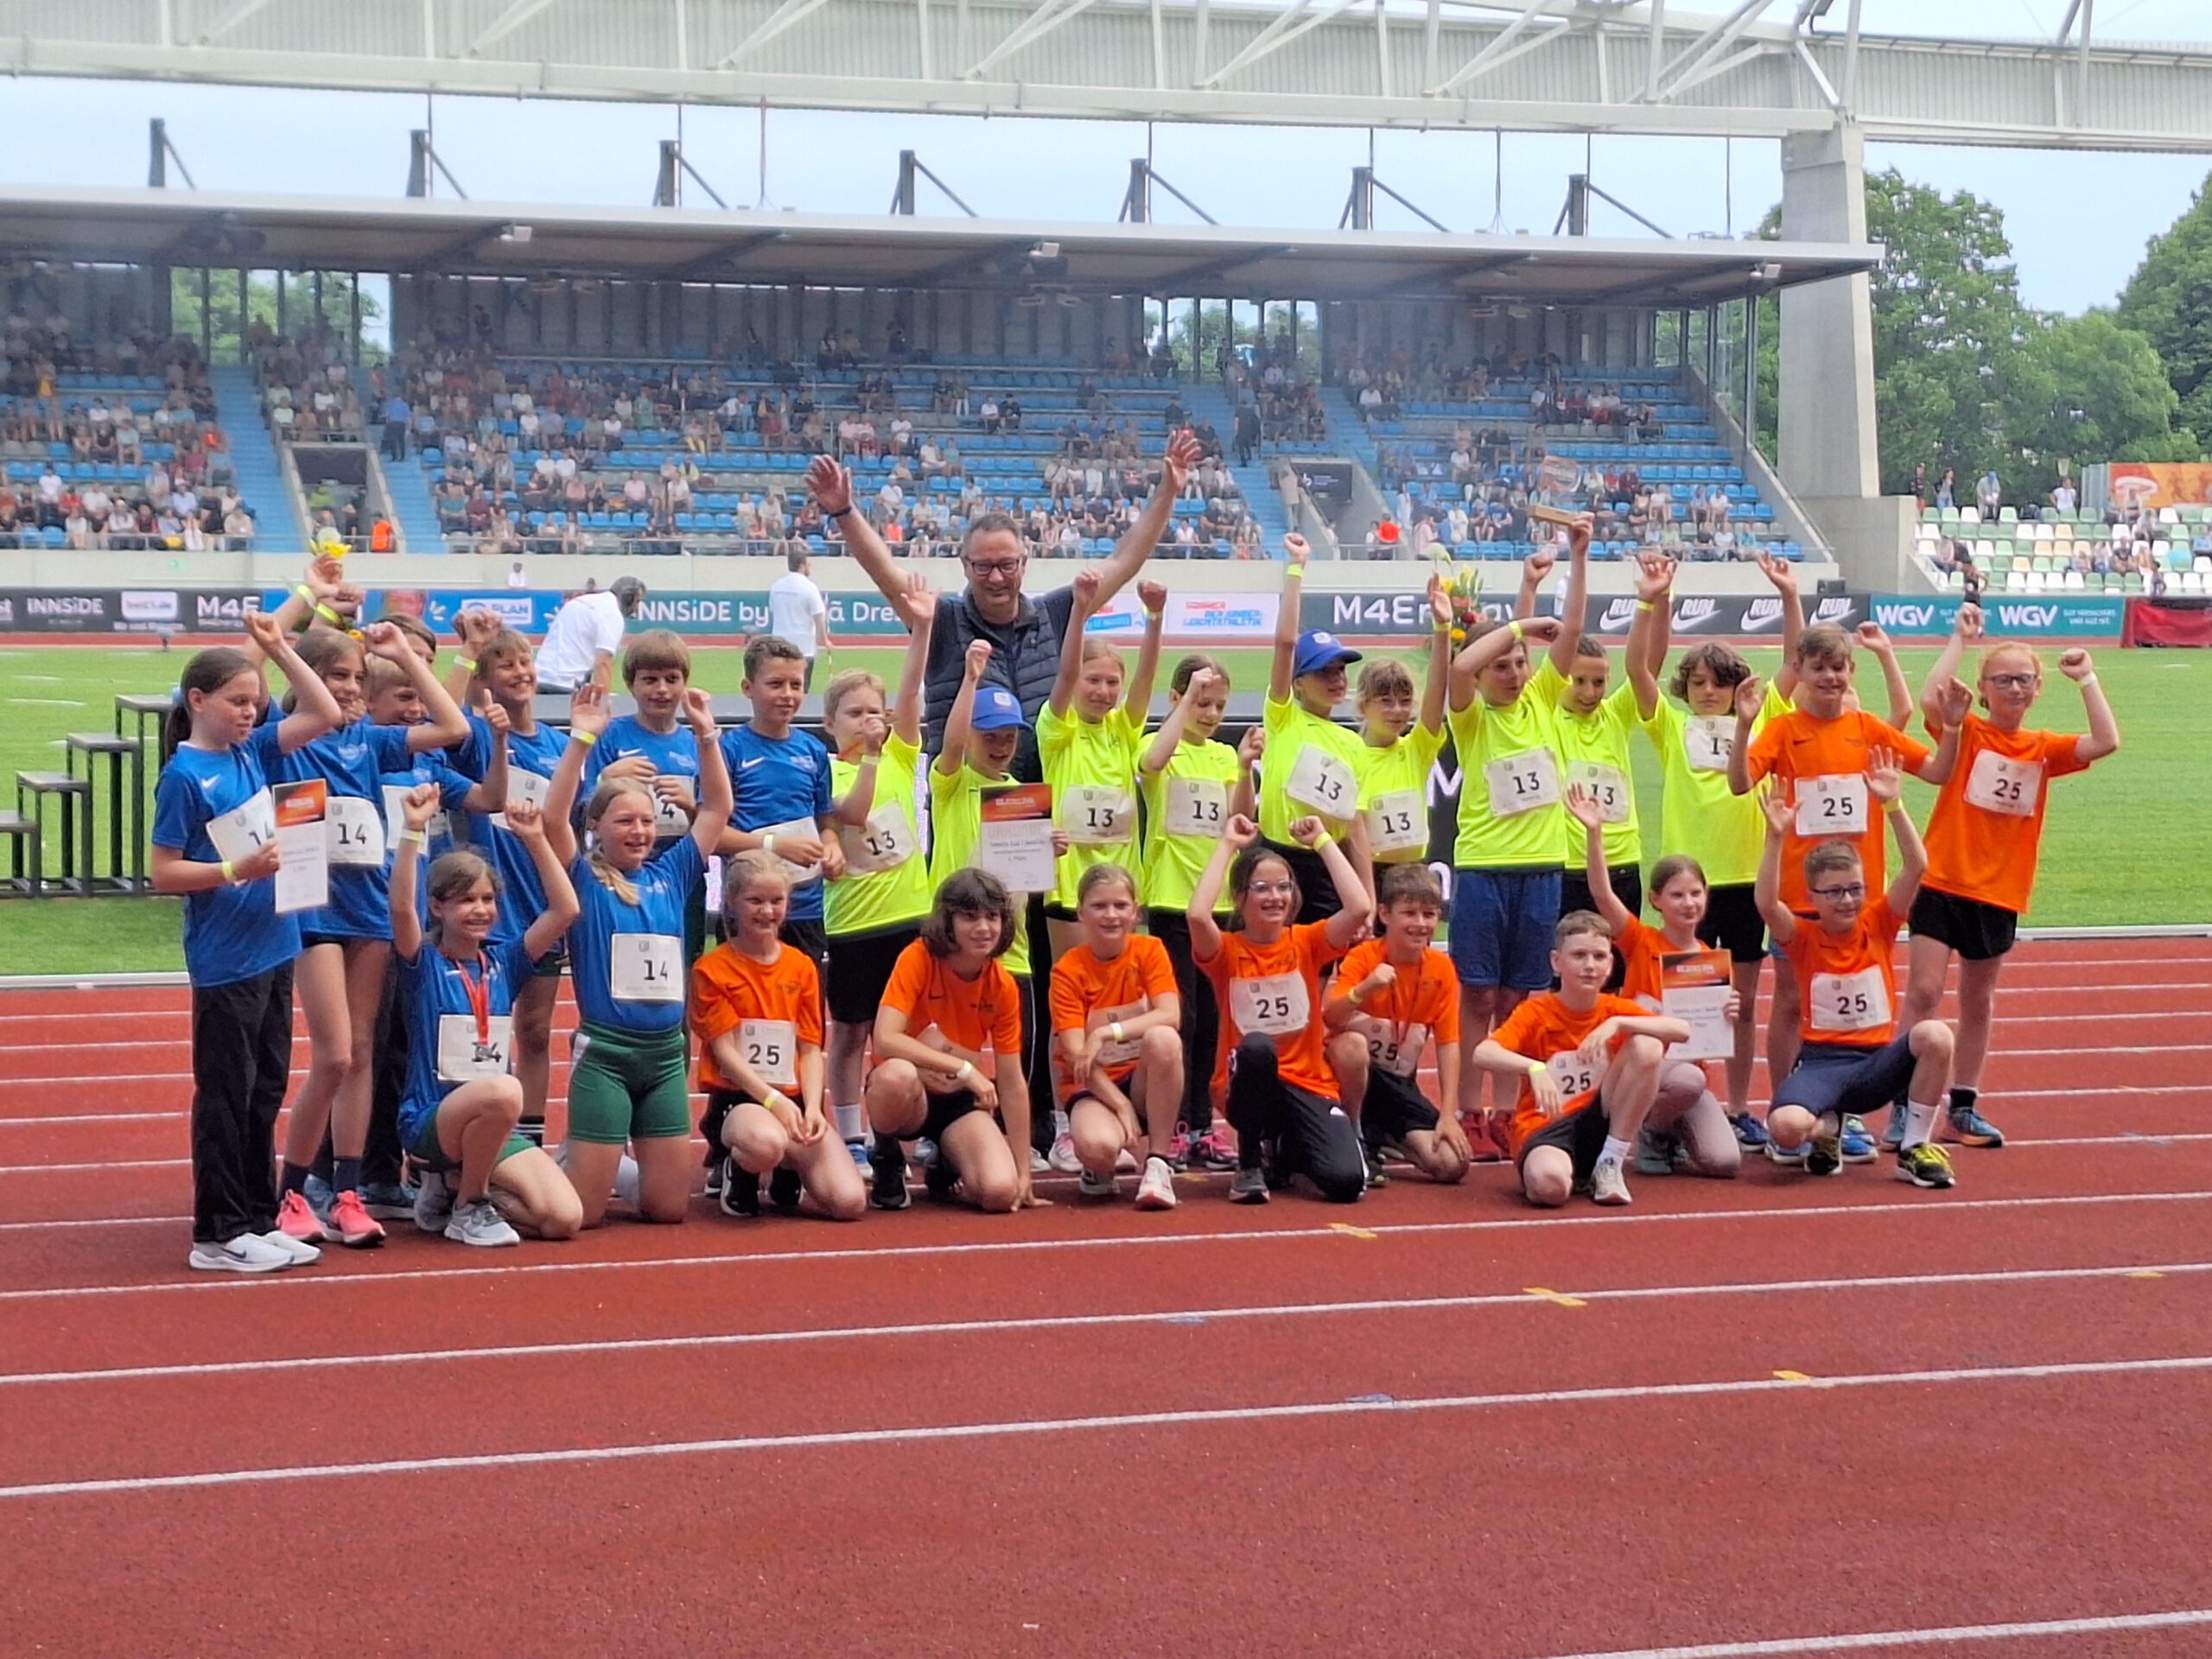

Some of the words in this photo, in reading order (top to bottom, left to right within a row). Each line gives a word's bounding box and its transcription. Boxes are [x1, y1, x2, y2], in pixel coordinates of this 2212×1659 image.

[639, 599, 732, 621] NNSiDE
[739, 601, 769, 627] by
[1681, 598, 1716, 615] RUN
[1818, 597, 1852, 616] RUN
[1876, 604, 1934, 626] WGV
[1999, 604, 2058, 627] WGV
[1314, 772, 1343, 801] 13
[1512, 771, 1540, 795] 13
[1993, 779, 2022, 800] 25
[1086, 807, 1115, 828] 13
[1192, 800, 1219, 822] 13
[1822, 797, 1853, 817] 25
[338, 823, 367, 845] 14
[1382, 811, 1411, 836] 13
[866, 830, 896, 856] 13
[644, 959, 669, 984] 14
[1255, 996, 1289, 1020] 25
[1836, 993, 1867, 1015] 25
[748, 1043, 780, 1066] 25
[1370, 1039, 1398, 1062] 25
[1560, 1071, 1592, 1096] 25
